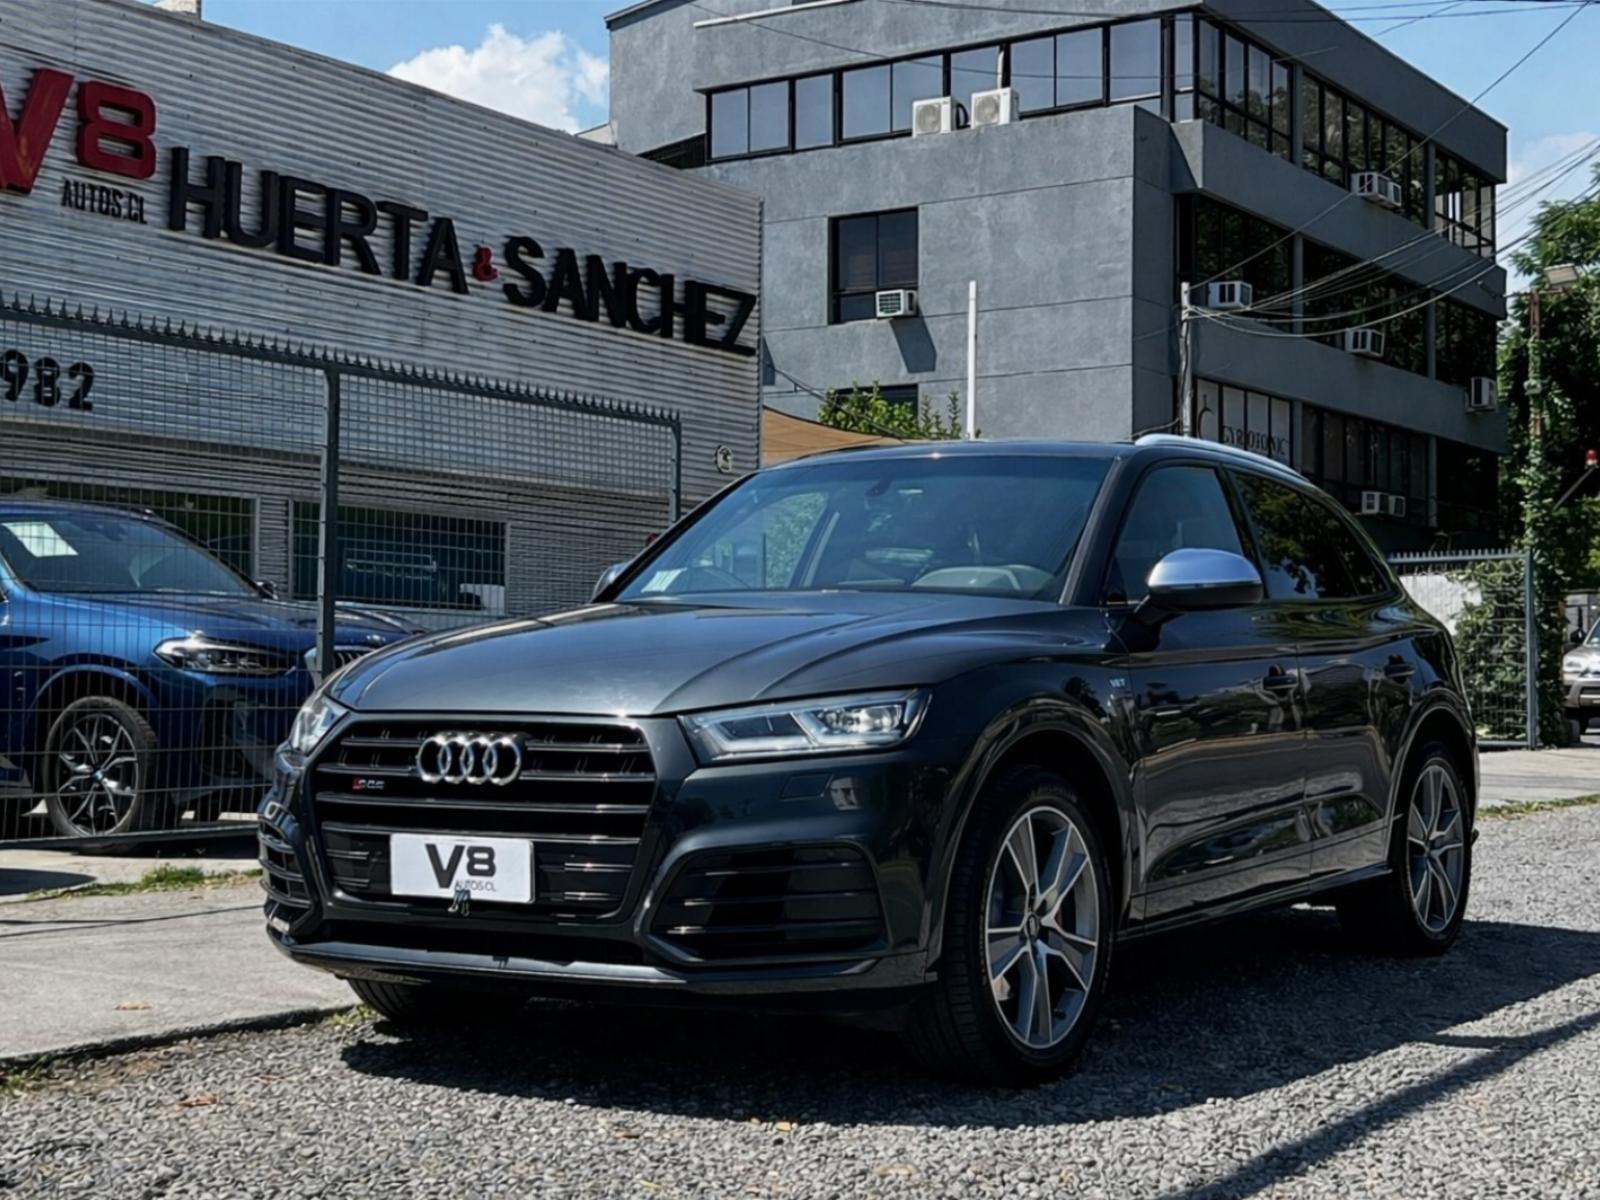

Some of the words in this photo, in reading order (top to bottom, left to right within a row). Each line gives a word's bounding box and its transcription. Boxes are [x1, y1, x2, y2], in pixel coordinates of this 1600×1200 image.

[0, 67, 156, 194] V8
[61, 177, 148, 224] AUTOS.CL
[168, 147, 469, 295] HUERTA
[472, 243, 498, 281] &
[502, 234, 757, 357] SANCHEZ
[425, 843, 496, 889] V8
